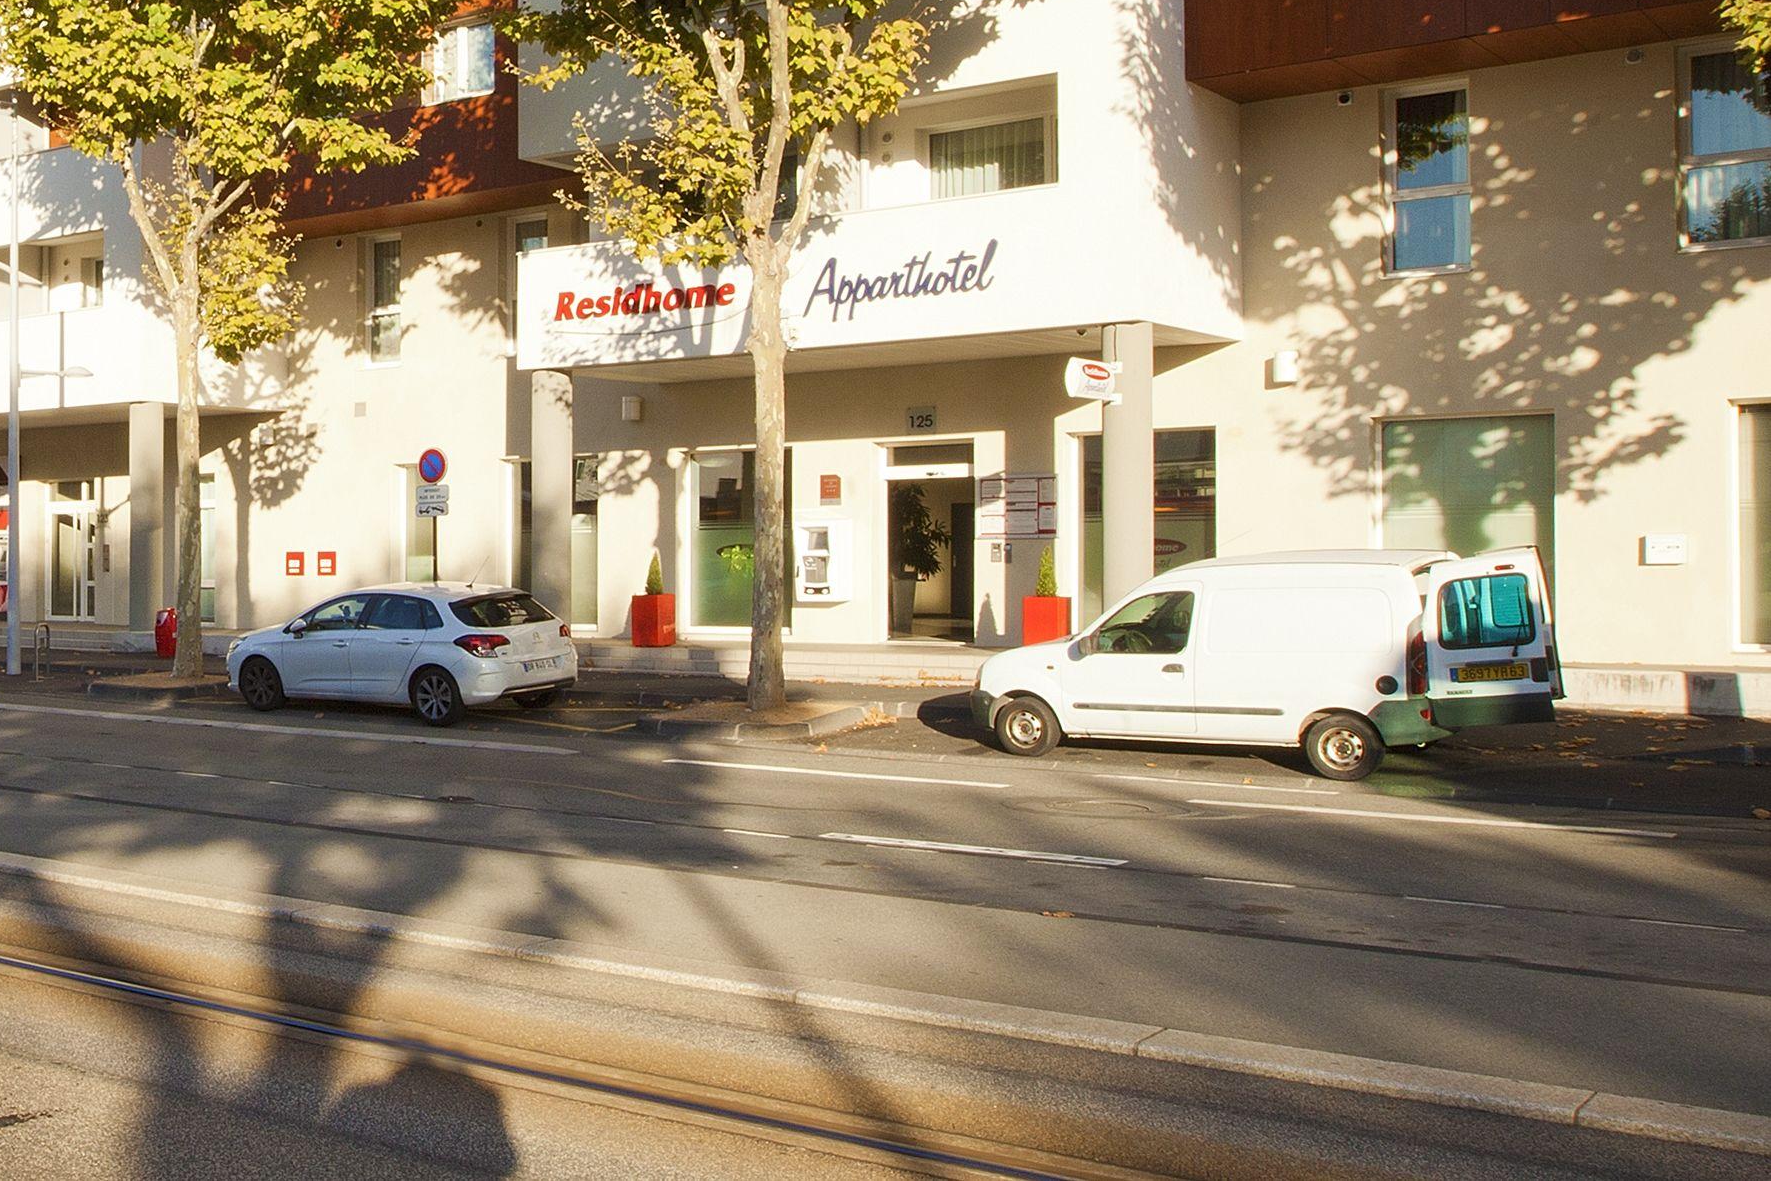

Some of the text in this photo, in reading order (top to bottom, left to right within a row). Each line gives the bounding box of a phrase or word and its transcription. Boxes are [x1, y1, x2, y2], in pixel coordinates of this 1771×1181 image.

[554, 238, 998, 322] Residhome Apparthotel
[909, 414, 933, 428] 125
